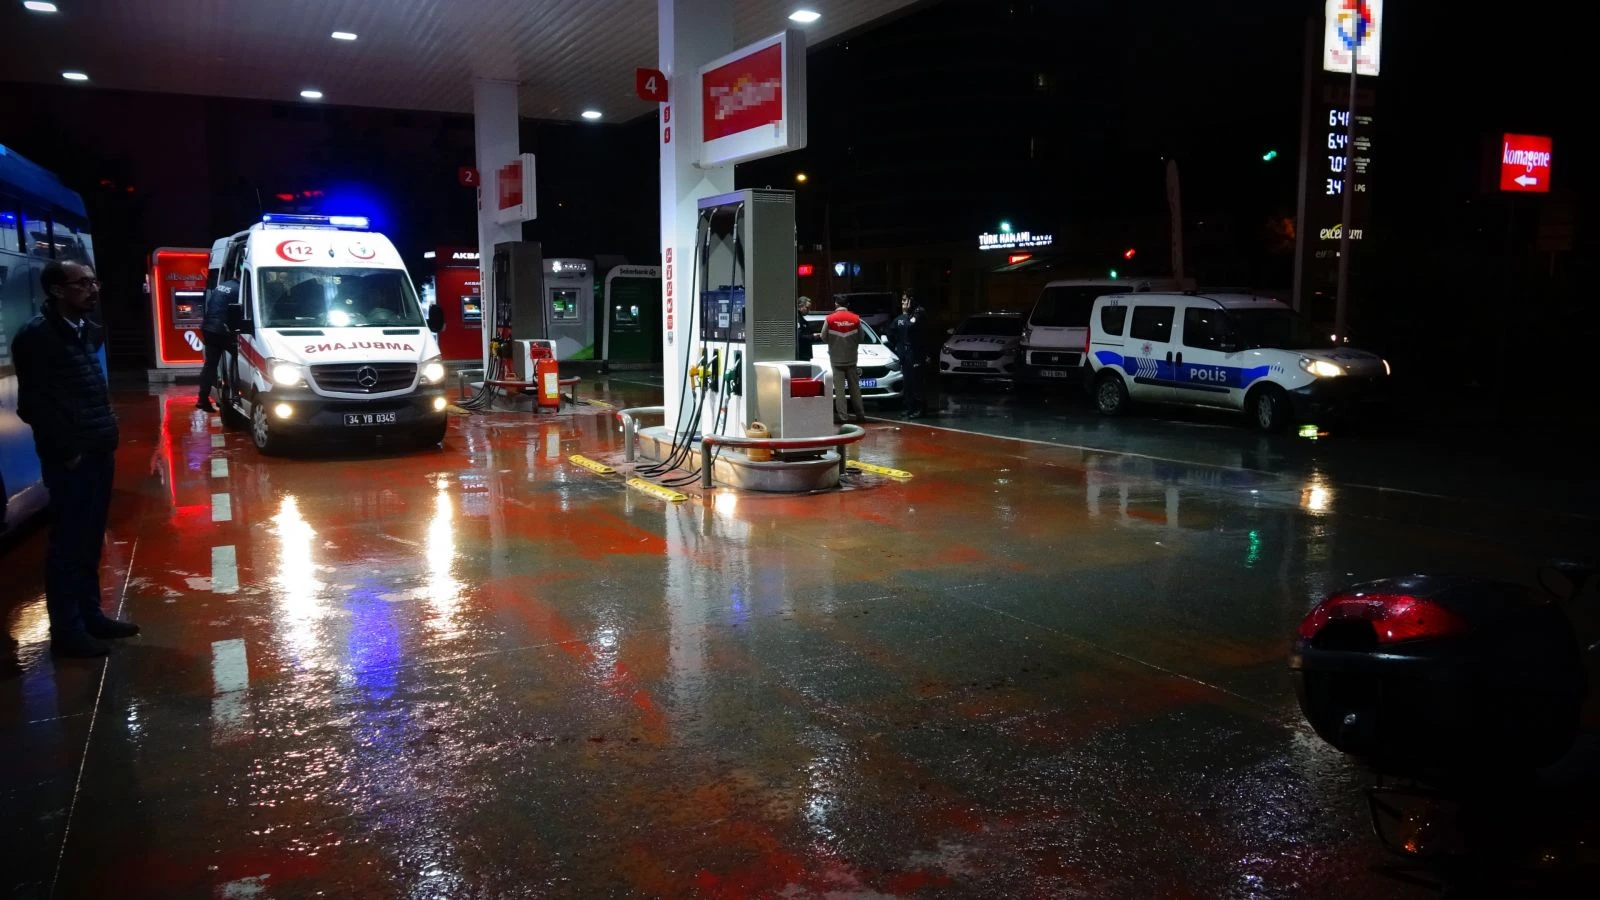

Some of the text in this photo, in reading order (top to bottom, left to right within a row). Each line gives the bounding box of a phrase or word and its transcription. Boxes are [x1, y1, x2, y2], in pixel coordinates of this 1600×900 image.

[645, 76, 657, 95] 4
[1503, 141, 1551, 172] komagene
[465, 171, 472, 182] 2
[1326, 179, 1345, 194] 3.4
[1354, 184, 1365, 192] LPG
[979, 232, 998, 245] TÜRK
[999, 231, 1030, 243] HAMAMI
[286, 246, 313, 255] 112
[1190, 366, 1227, 382] POLİS
[349, 413, 395, 424] 34 YB 0345
